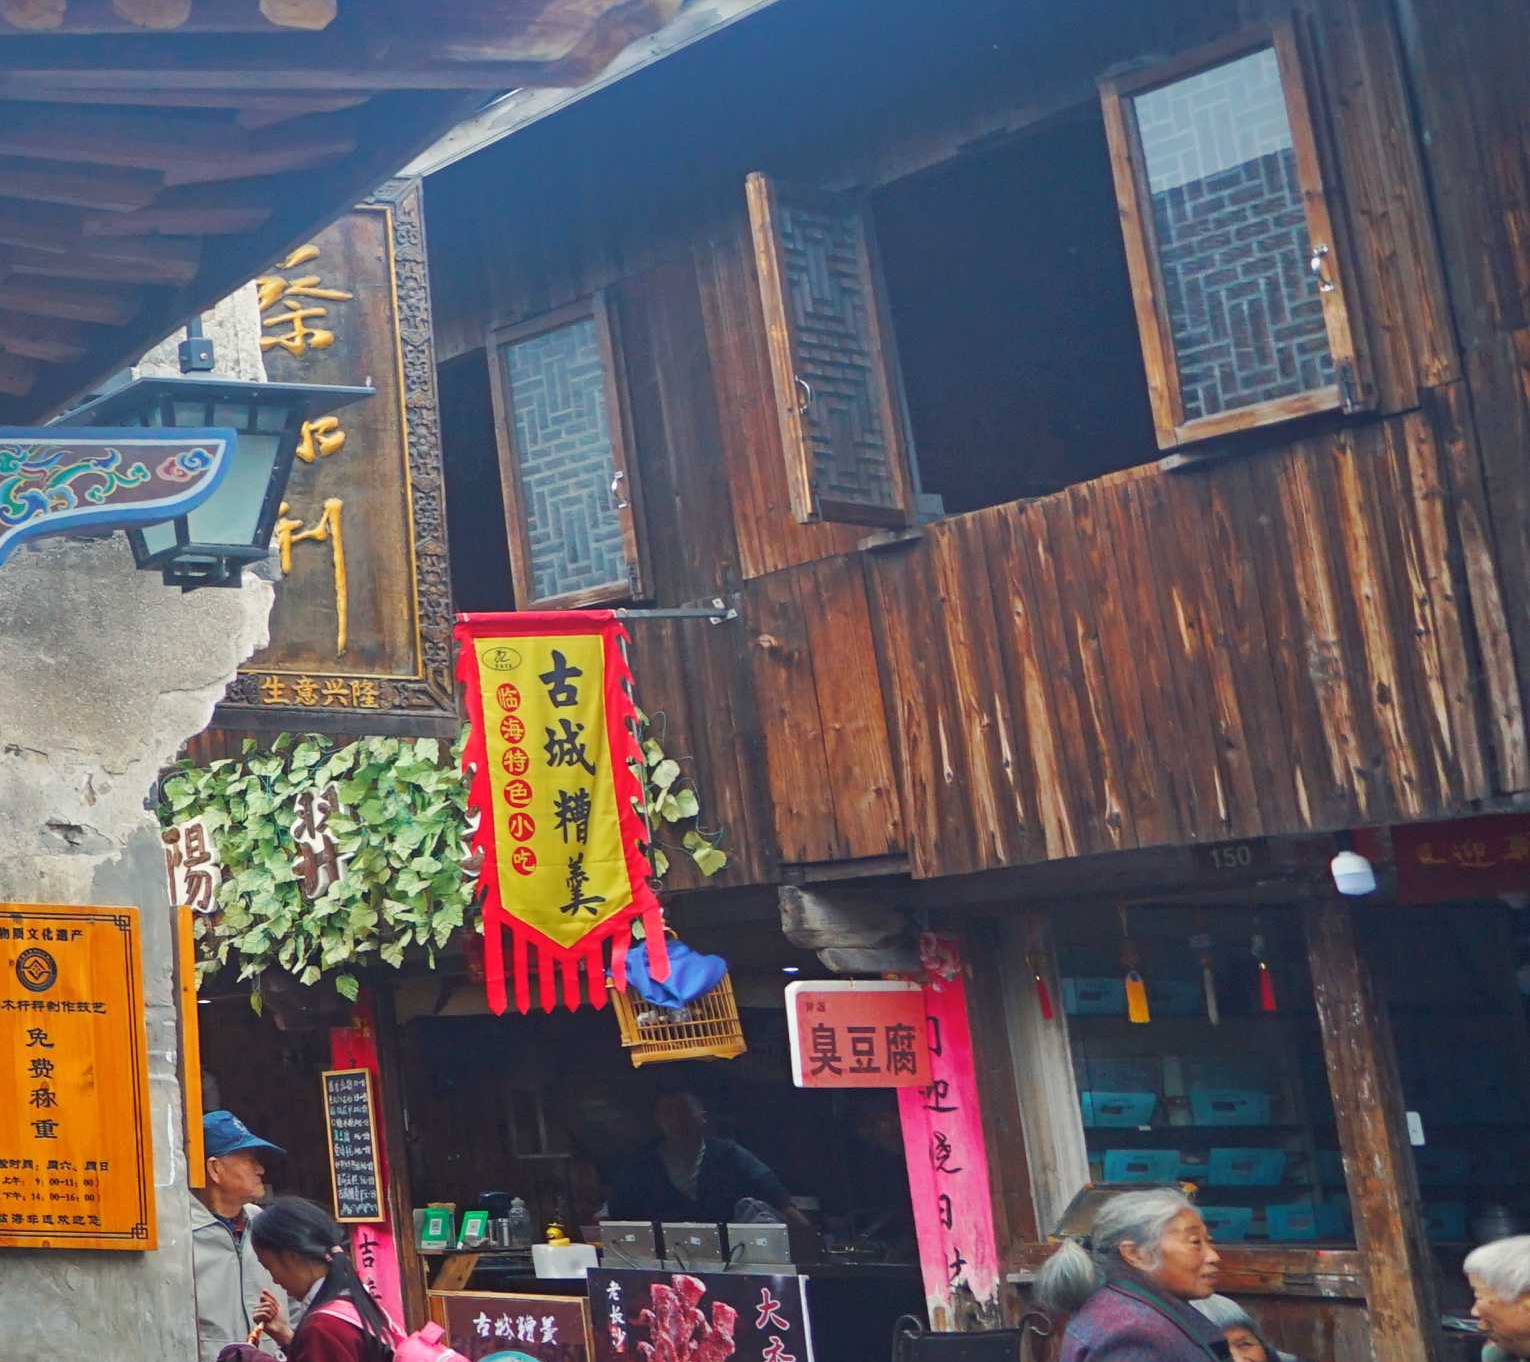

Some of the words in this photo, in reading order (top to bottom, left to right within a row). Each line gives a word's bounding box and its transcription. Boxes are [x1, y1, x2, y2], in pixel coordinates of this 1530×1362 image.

[260, 675, 381, 709] 生意兴隆
[497, 682, 537, 876] 临海特色小吃
[538, 649, 606, 918] 古城糟羹
[1211, 846, 1250, 871] 150
[25, 1026, 60, 1140] 免费称重
[809, 1023, 917, 1076] 臭豆腐
[606, 1280, 627, 1348] 老长沙
